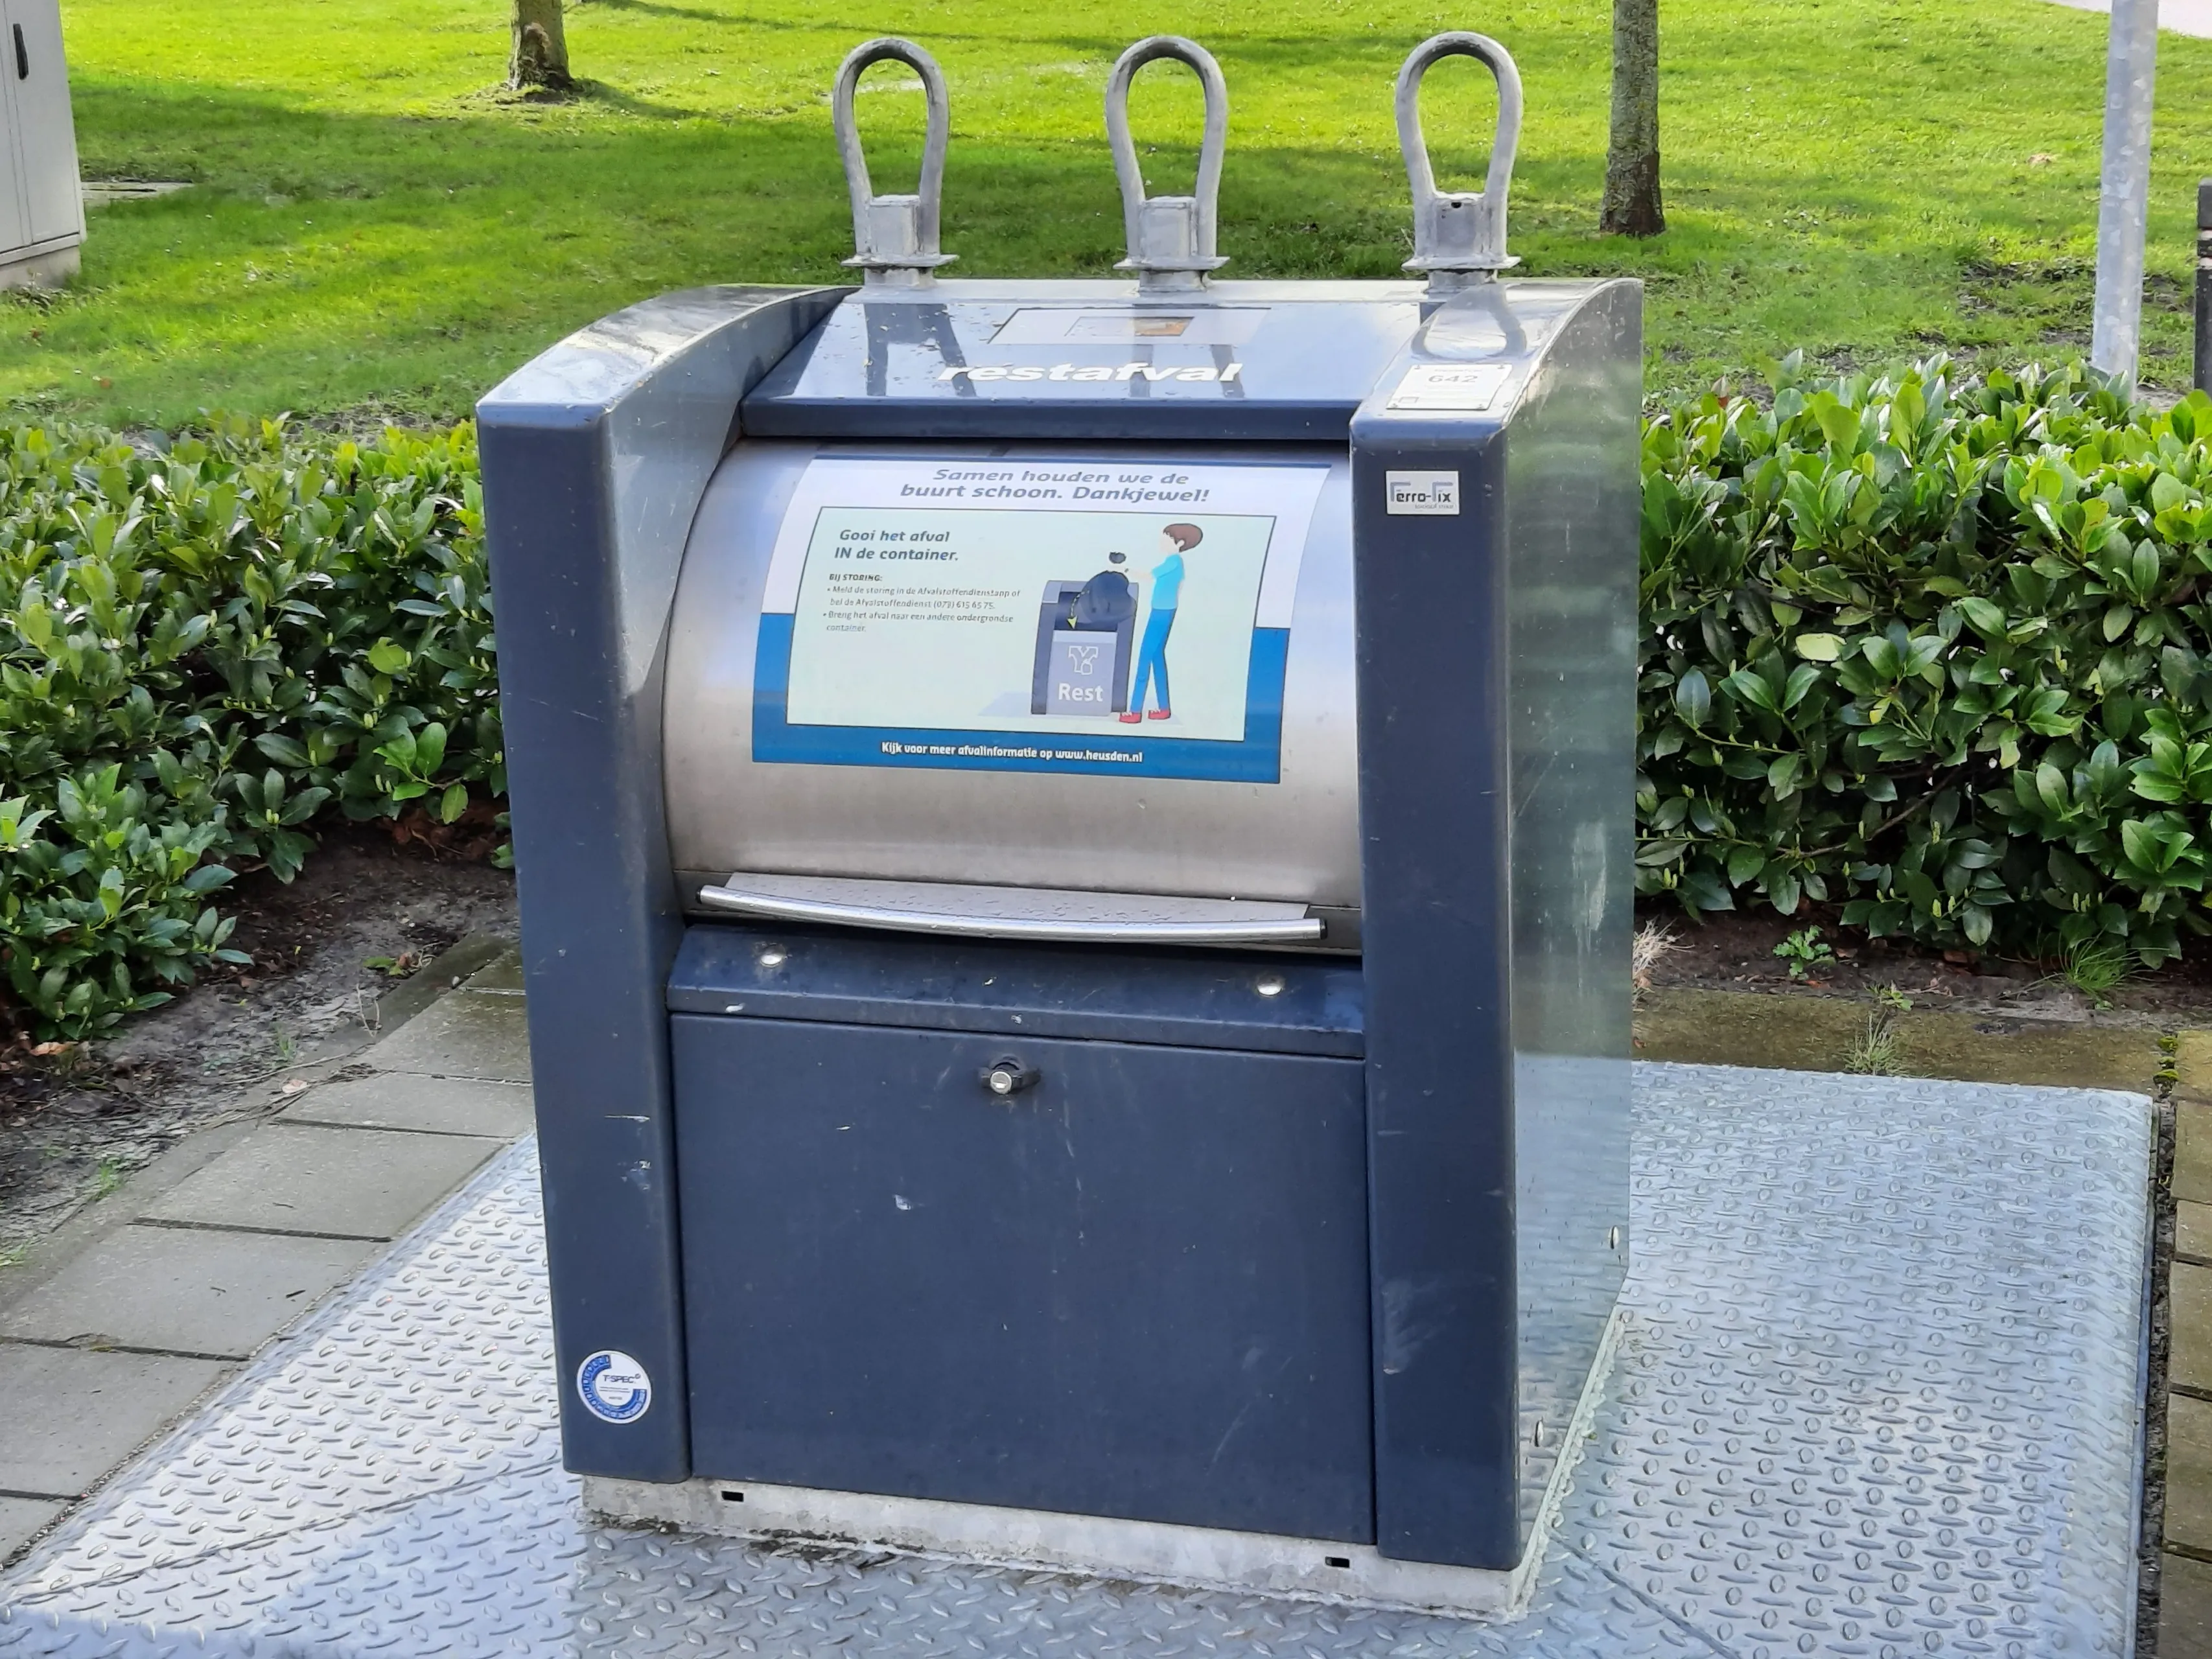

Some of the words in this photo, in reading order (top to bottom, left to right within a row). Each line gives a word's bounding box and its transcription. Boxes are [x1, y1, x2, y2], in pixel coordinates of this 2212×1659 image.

[937, 362, 1243, 382] restafval
[1428, 375, 1478, 384] 642
[933, 469, 1013, 481] Samen
[1021, 470, 1110, 483] houden
[1118, 473, 1153, 484] we
[1160, 472, 1189, 485] de
[900, 484, 966, 498] buurt
[972, 485, 1063, 500] schoon.
[1072, 487, 1210, 504] Dankjewel!
[839, 529, 876, 541] Gooi
[879, 530, 906, 542] het
[909, 530, 951, 542] afval
[834, 547, 852, 559] IN
[856, 548, 875, 560] de
[879, 549, 959, 561] container.
[829, 574, 841, 582] BIJ
[842, 574, 883, 582] STORING:
[866, 586, 895, 596] storing
[830, 597, 843, 606] bel
[828, 610, 852, 621] Breng
[853, 611, 867, 620] het
[868, 611, 889, 620] afval
[926, 613, 955, 621] andere
[957, 614, 1014, 624] ondergrondse
[826, 623, 867, 632] container.
[1058, 682, 1104, 702] Rest
[881, 741, 902, 755] Kijk
[904, 745, 928, 754] voor
[929, 745, 955, 756] meer
[958, 745, 1037, 759] afvalinformatie
[1040, 749, 1053, 761] op
[1054, 750, 1143, 763] www.heusden.nl
